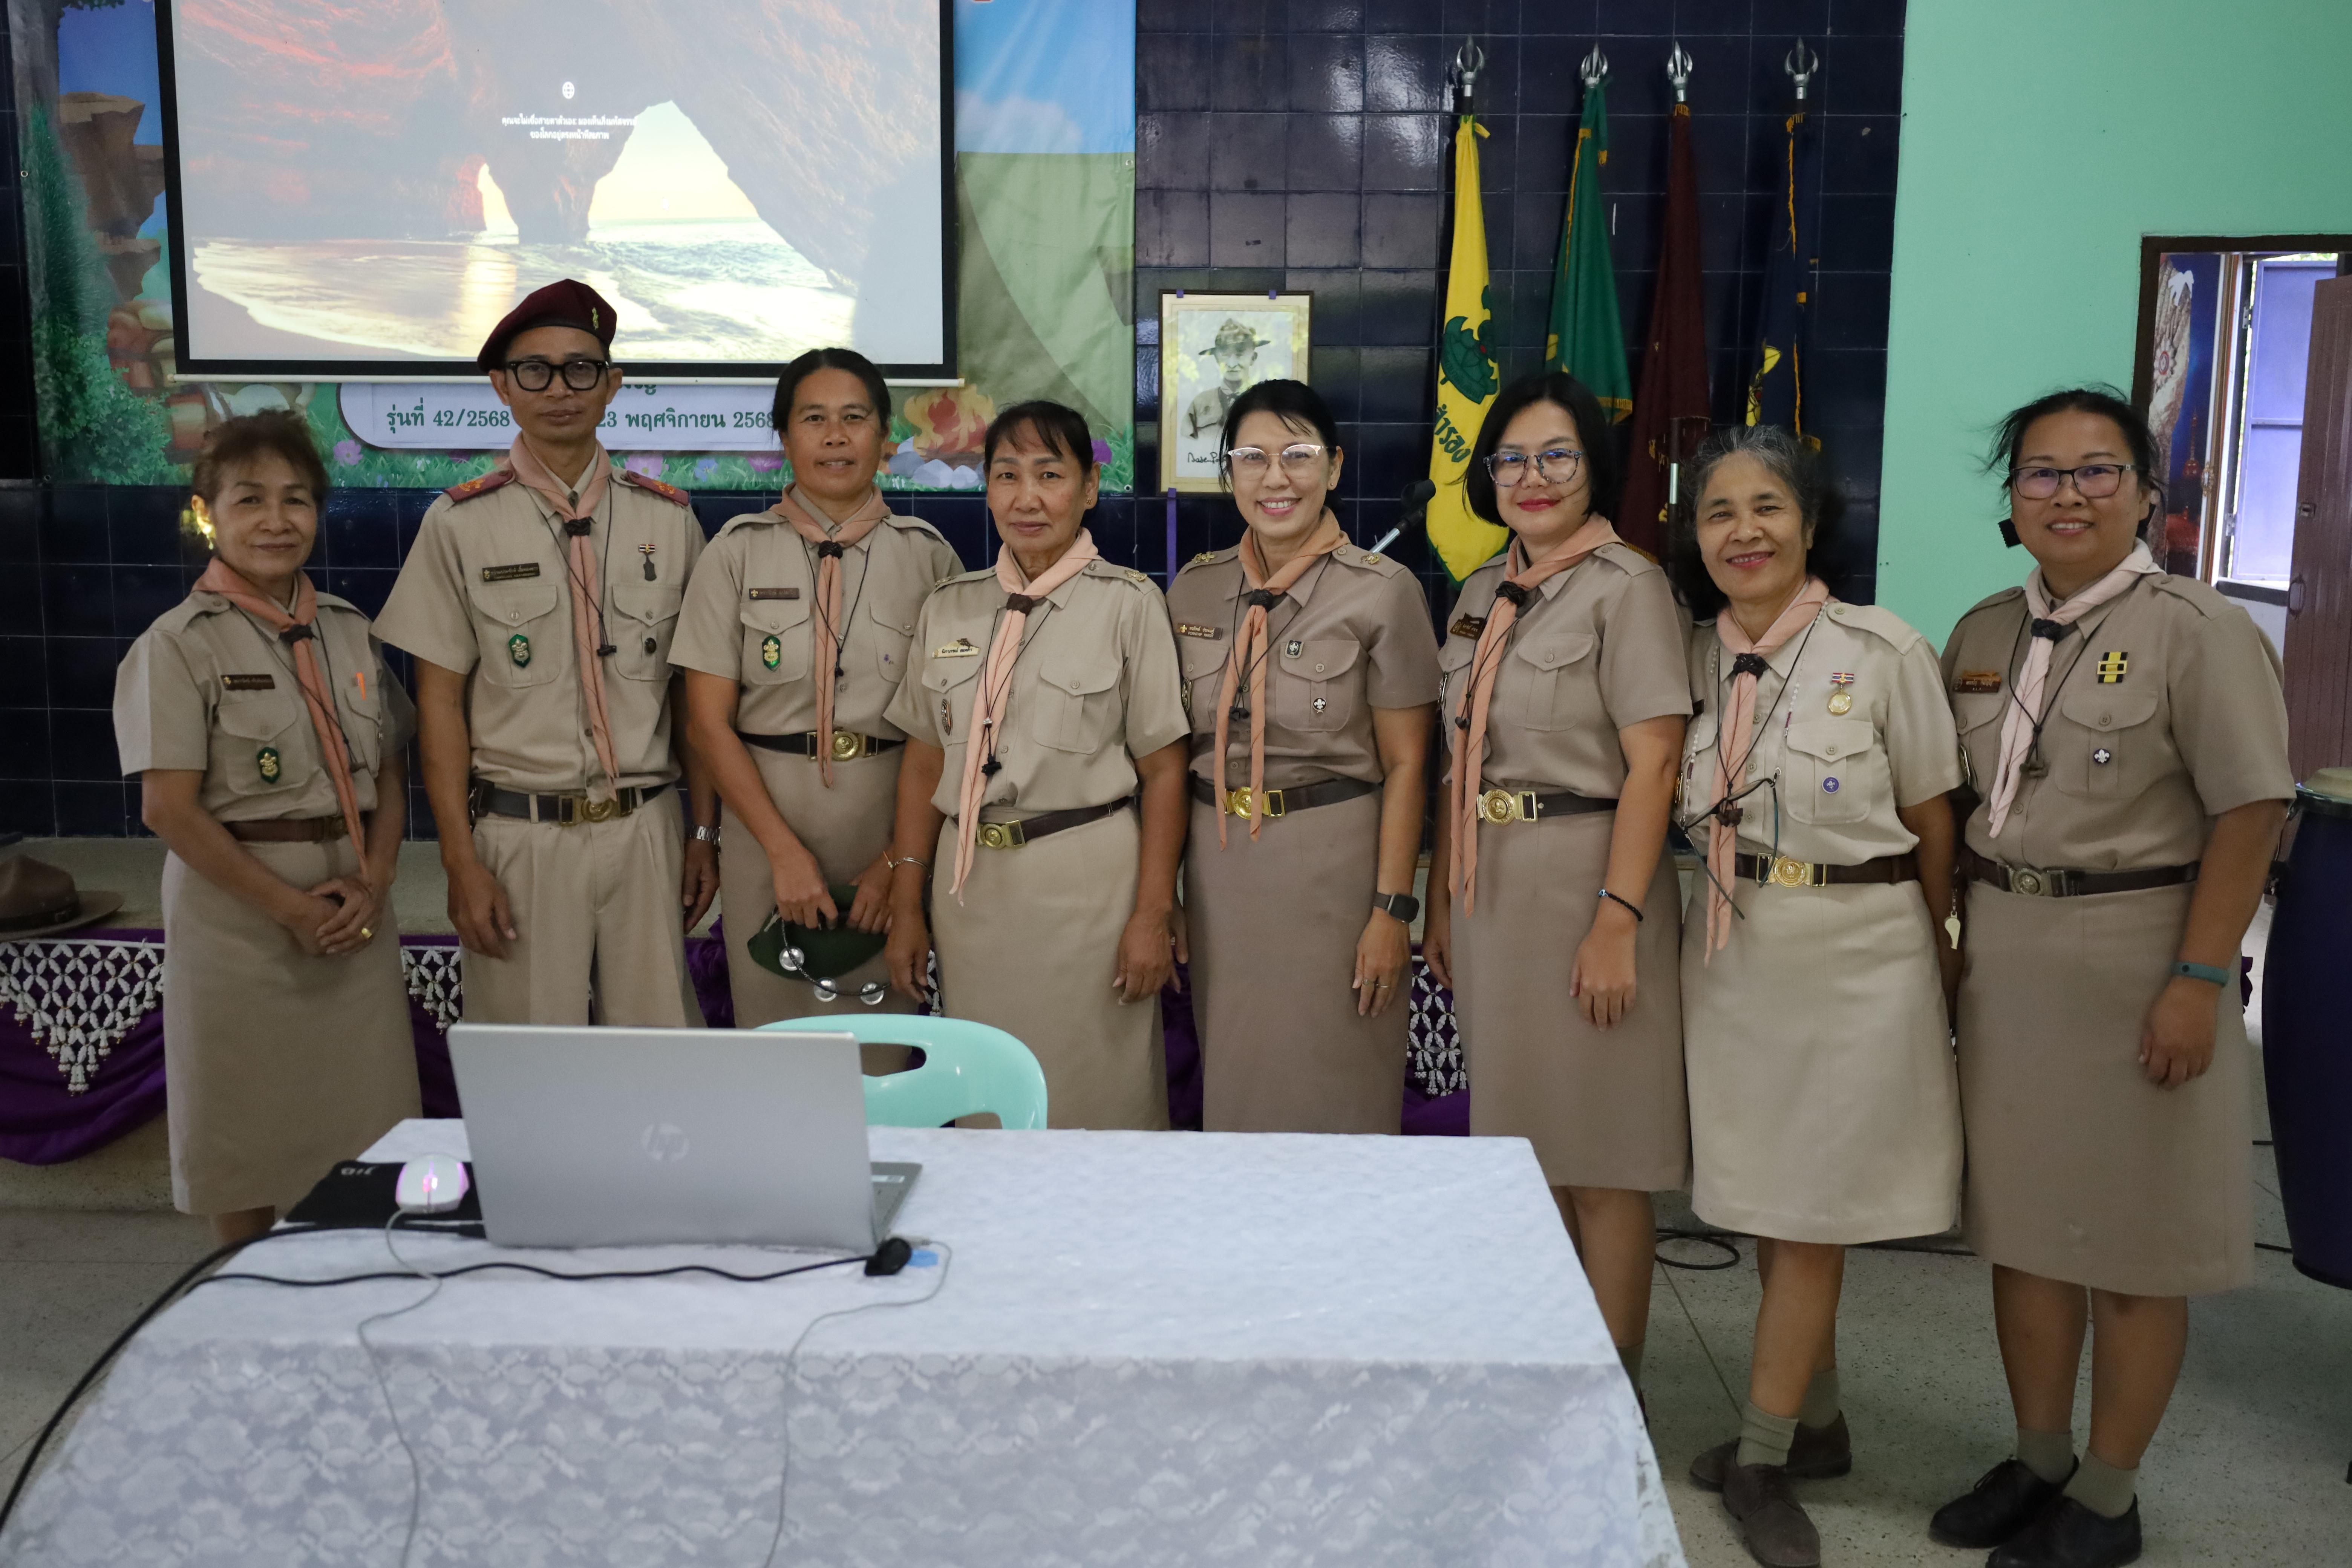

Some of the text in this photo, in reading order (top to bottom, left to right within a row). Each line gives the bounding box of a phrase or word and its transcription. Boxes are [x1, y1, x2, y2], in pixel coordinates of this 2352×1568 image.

[386, 397, 424, 434] รุ่นที่
[433, 408, 510, 427] 42/2568
[625, 407, 726, 431] พฤศจิกายน
